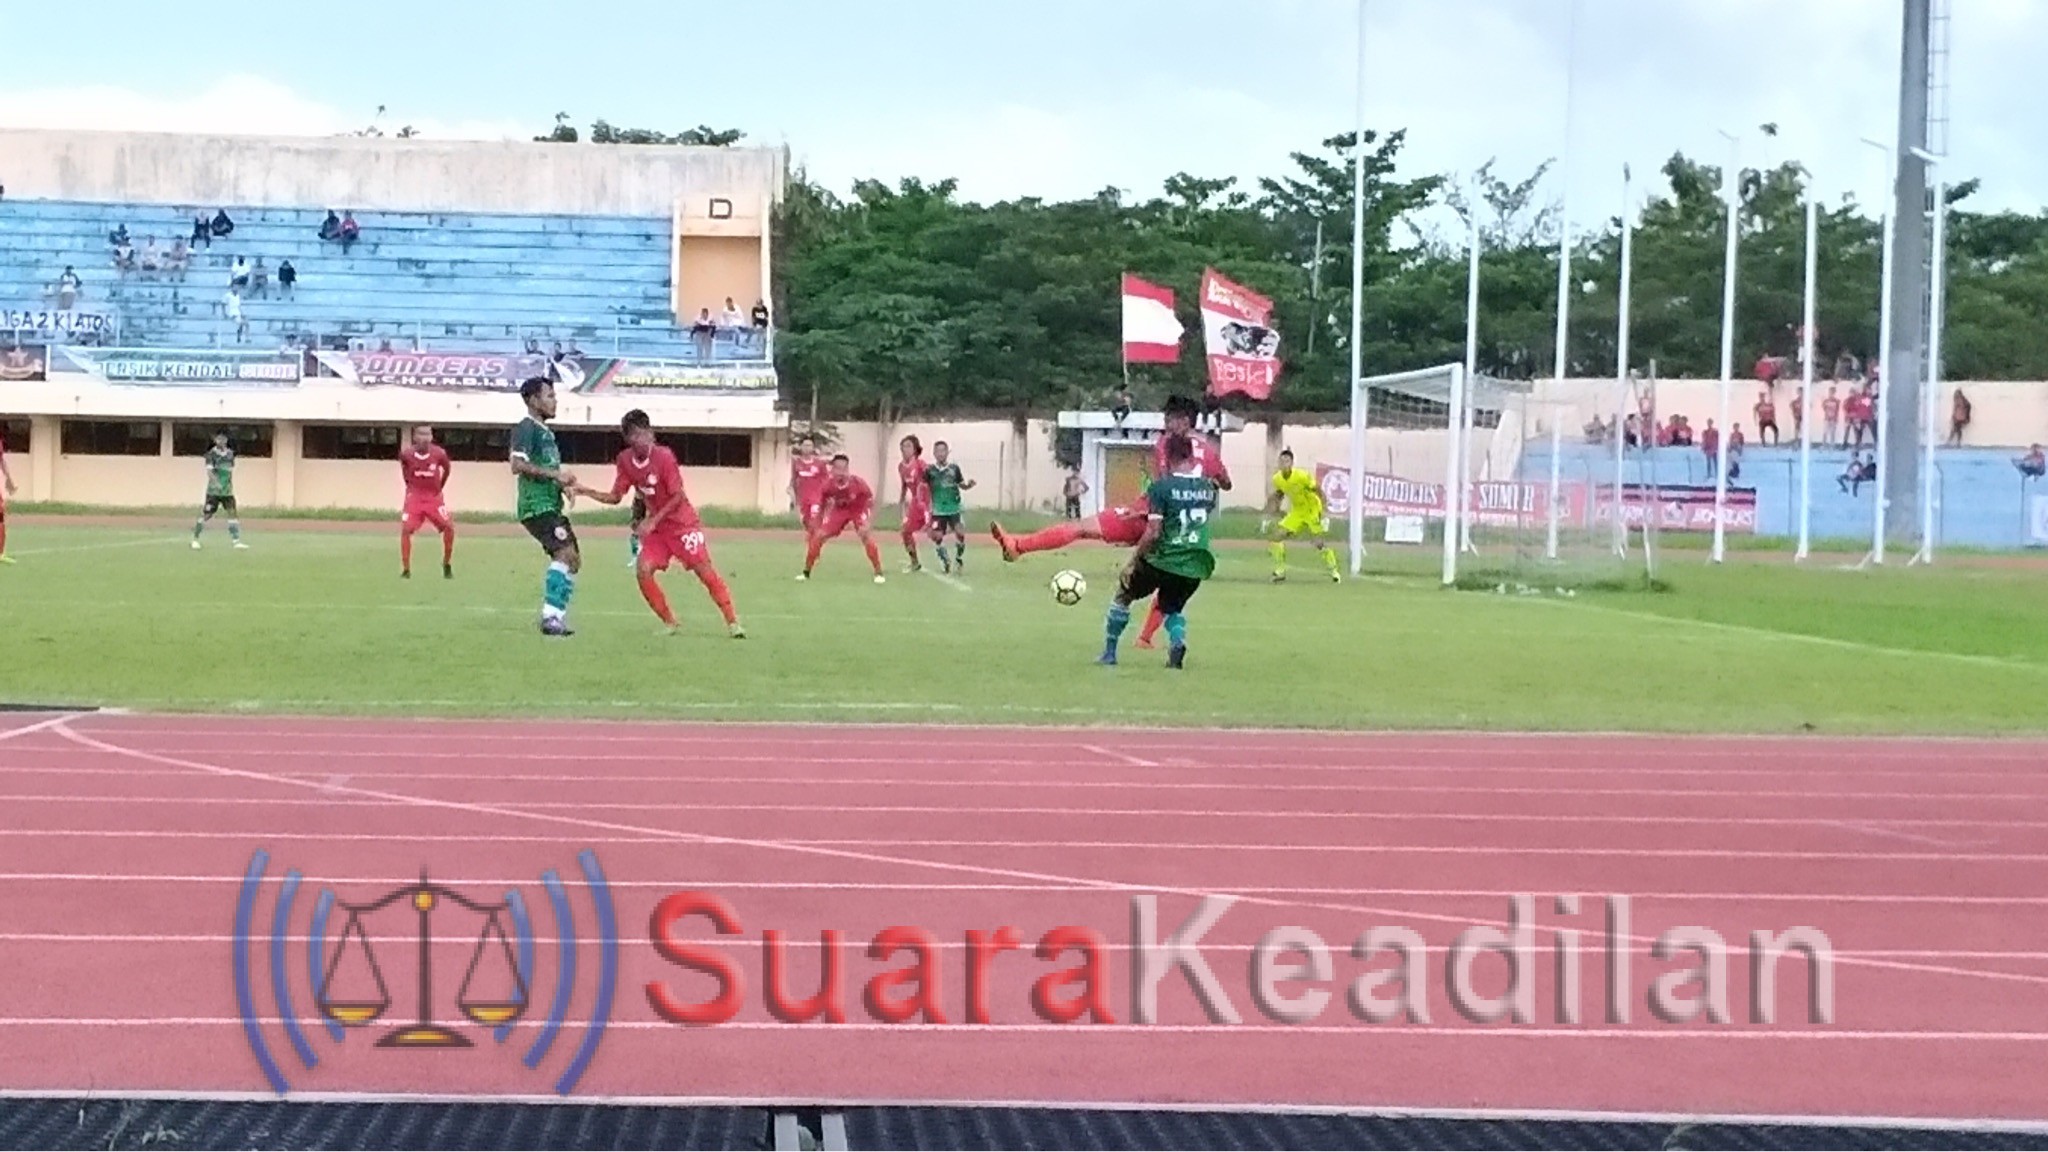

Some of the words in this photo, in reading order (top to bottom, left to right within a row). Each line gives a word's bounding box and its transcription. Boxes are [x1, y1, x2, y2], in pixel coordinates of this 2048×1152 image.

[708, 197, 733, 219] D
[0, 309, 34, 328] IGA
[36, 311, 49, 329] 2
[161, 363, 236, 378] KENDAL
